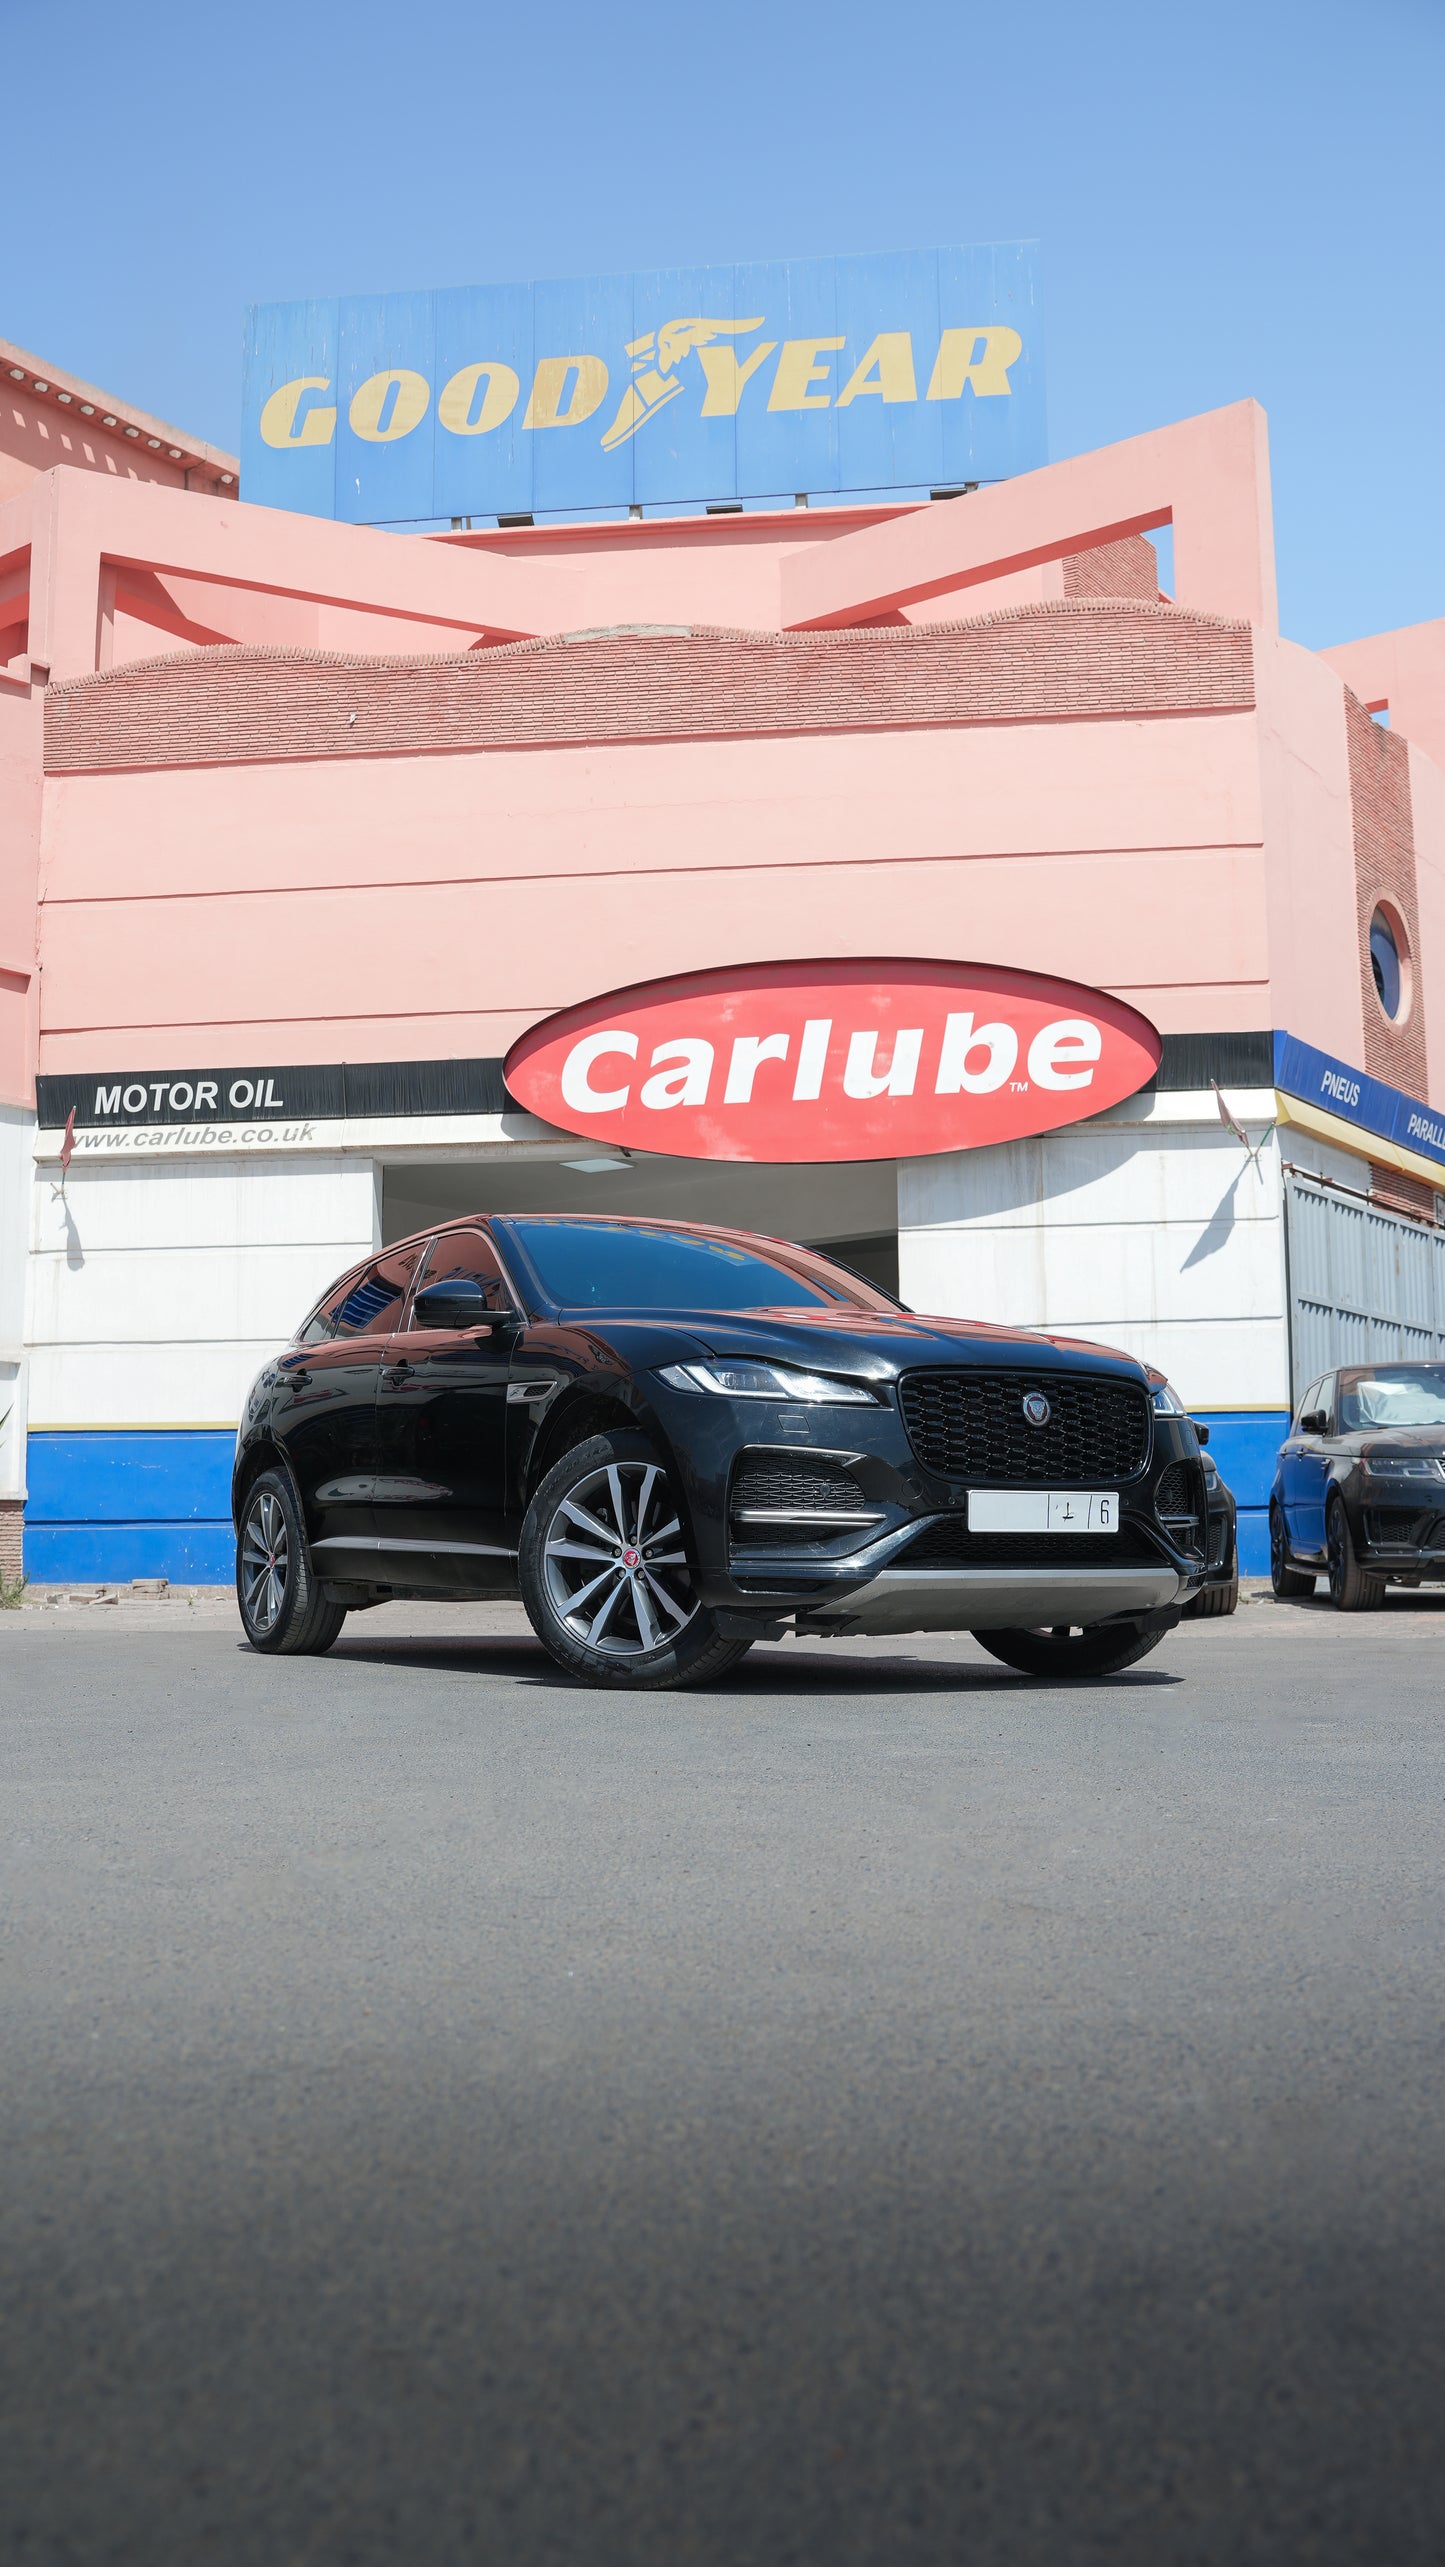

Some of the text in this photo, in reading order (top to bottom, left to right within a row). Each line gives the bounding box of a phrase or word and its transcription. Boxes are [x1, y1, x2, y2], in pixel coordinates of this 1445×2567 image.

[561, 1012, 1102, 1113] Carlube
[95, 1080, 283, 1114] MOTOR OIL
[1009, 1081, 1028, 1092] TM
[1320, 1070, 1360, 1106] PNEUS
